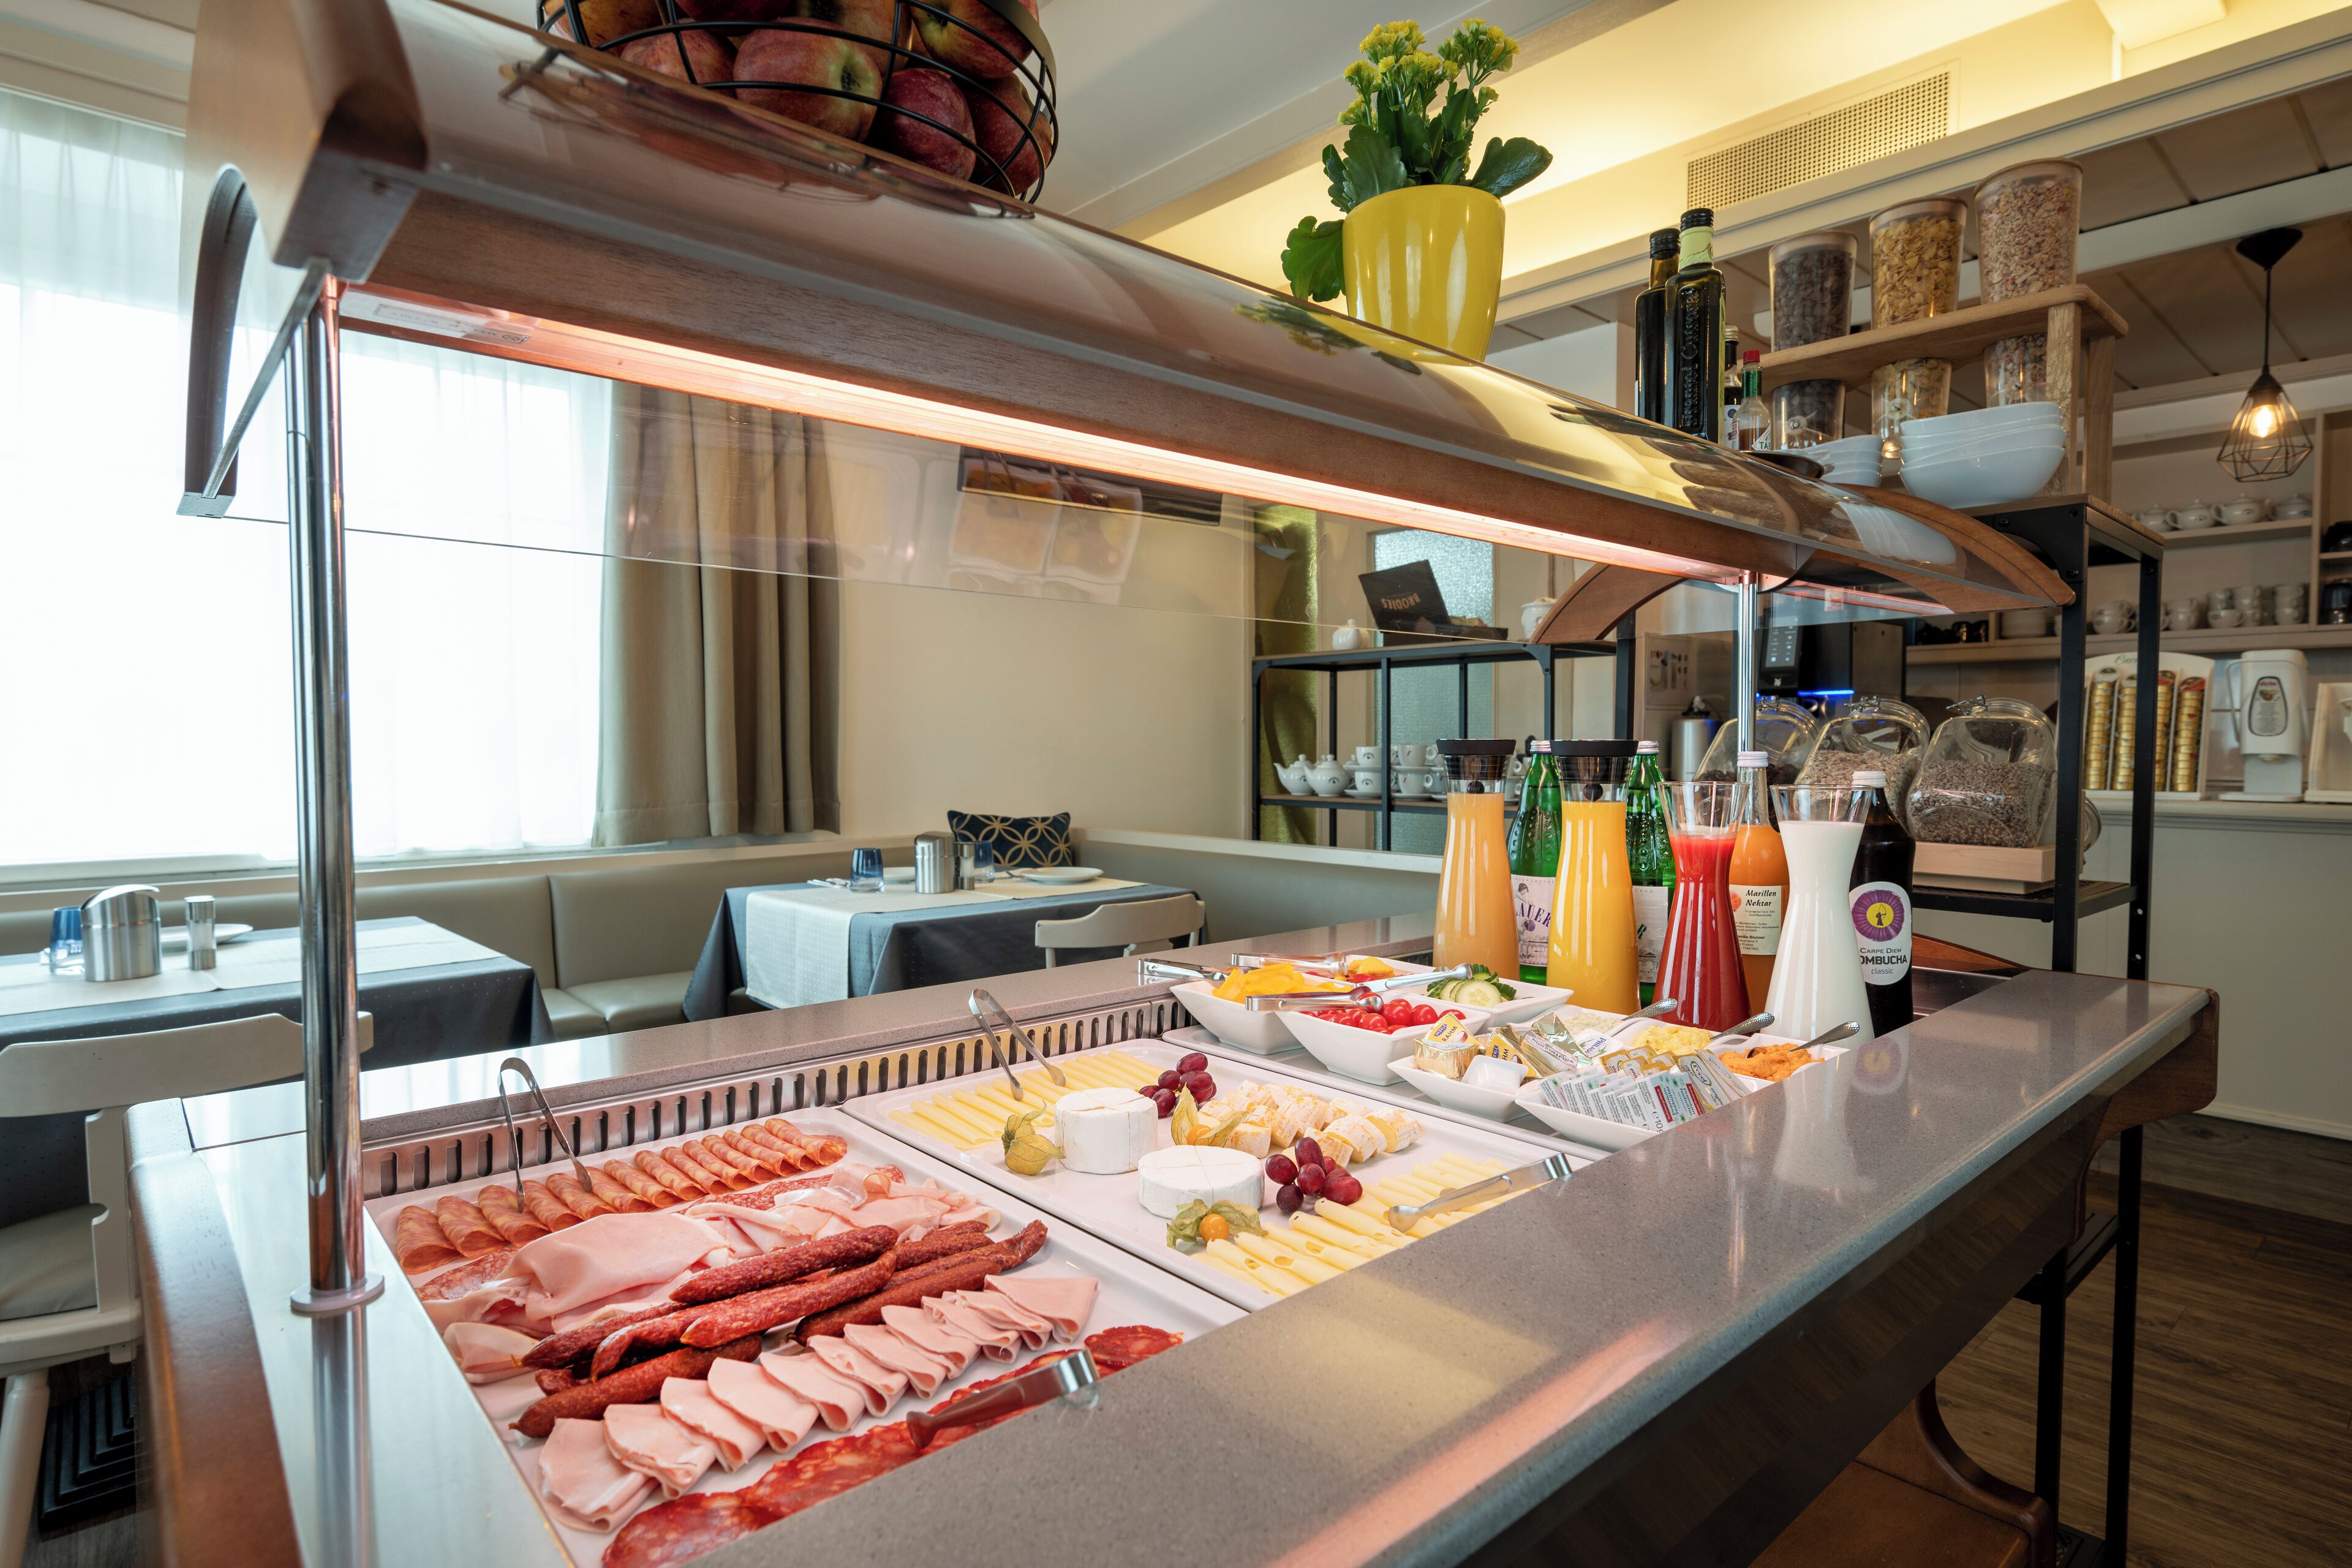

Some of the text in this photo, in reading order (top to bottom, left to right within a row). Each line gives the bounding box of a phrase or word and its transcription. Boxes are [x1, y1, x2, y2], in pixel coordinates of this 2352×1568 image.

[1381, 592, 1420, 610] BRODIES
[1515, 902, 1553, 927] AUER
[1860, 954, 1908, 965] OMBUCHA
[1442, 1026, 1458, 1042] RAHM
[1680, 1088, 1693, 1115] Teebutter
[1684, 1088, 1695, 1114] Premium
